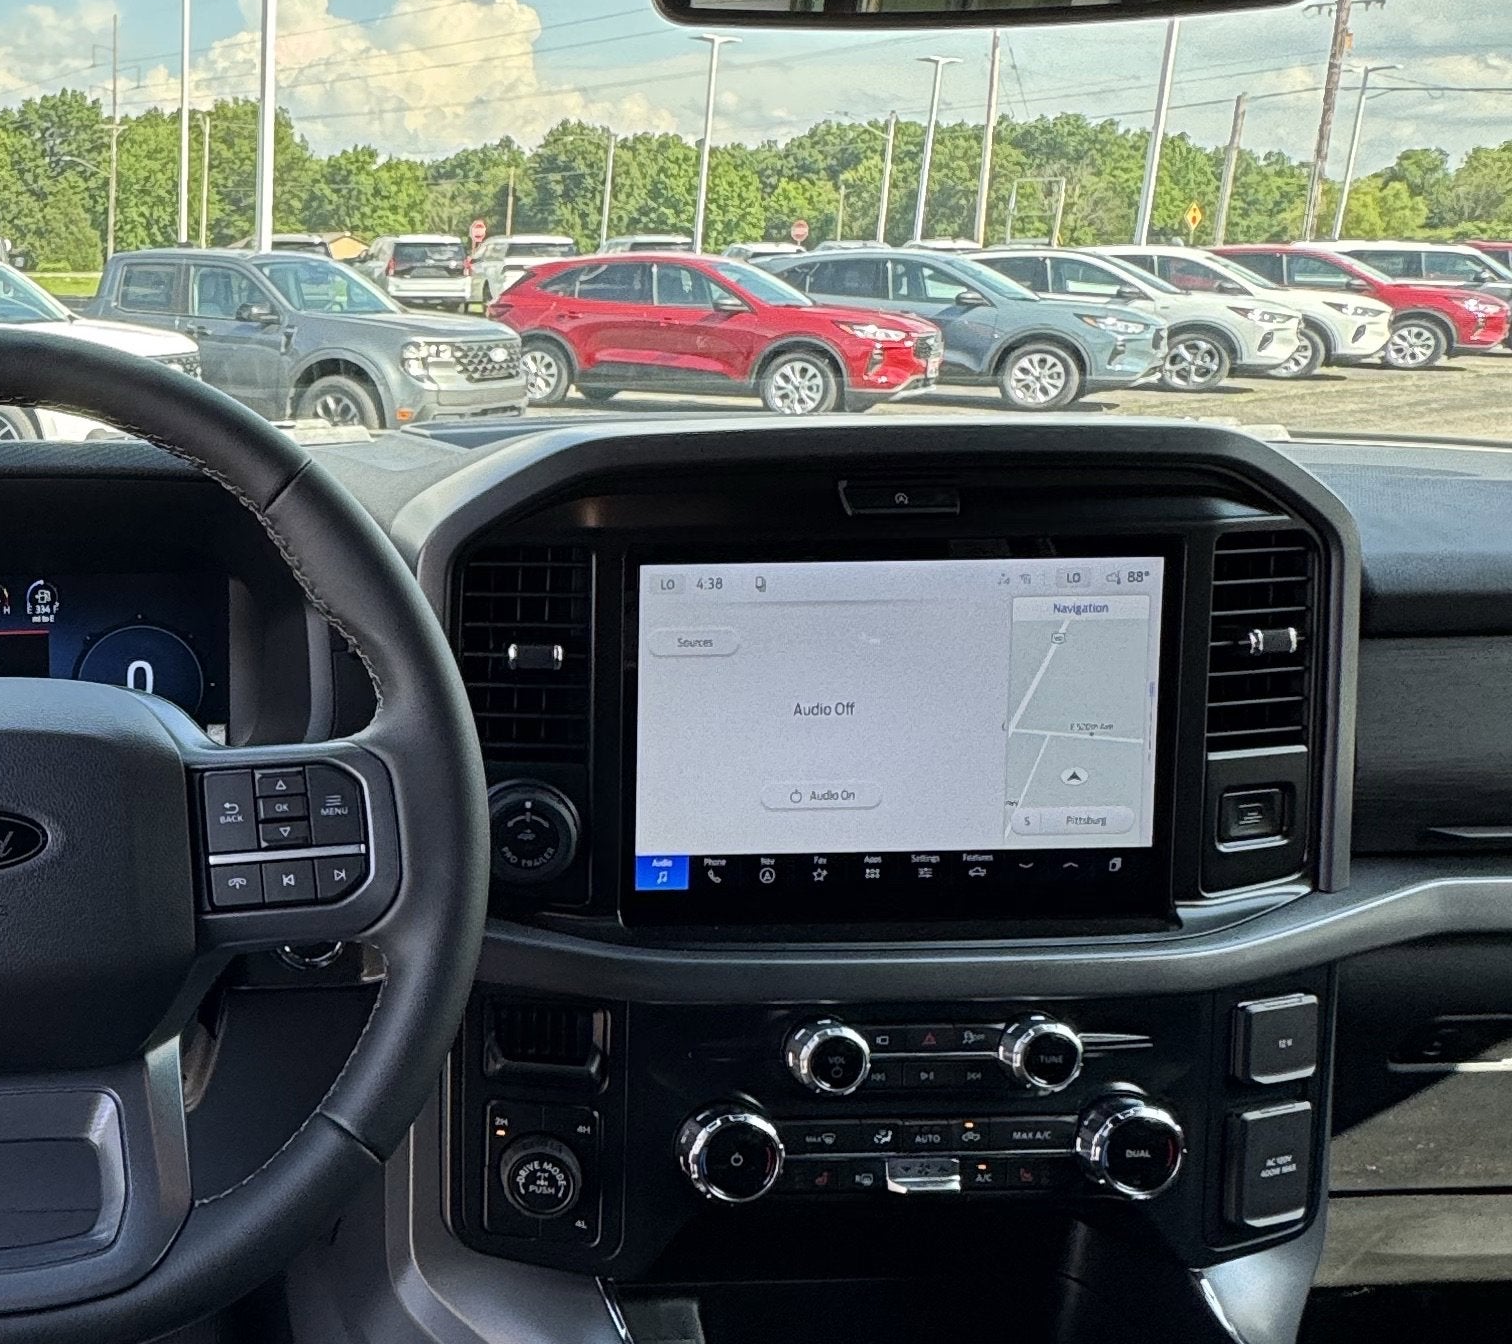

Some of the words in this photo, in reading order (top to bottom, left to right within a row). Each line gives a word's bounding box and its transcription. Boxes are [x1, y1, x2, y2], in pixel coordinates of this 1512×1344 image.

[1066, 572, 1081, 583] LO
[660, 578, 675, 590] LO
[696, 577, 723, 590] 4:38
[1053, 603, 1109, 615] Navigation
[677, 637, 713, 648] Sources
[127, 660, 154, 695] 0
[793, 702, 832, 716] Audio
[835, 701, 855, 716] Off
[809, 790, 839, 801] Audio
[840, 789, 856, 801] On
[274, 803, 289, 813] OK
[320, 807, 349, 816] MENU
[219, 815, 244, 824] BACK
[1066, 816, 1107, 827] Pittsburg
[651, 858, 673, 868] Audio
[1038, 1054, 1064, 1065] TUNE
[915, 1134, 941, 1144] AUTO
[1034, 1130, 1052, 1141] A/C
[1125, 1148, 1151, 1159] DUAL
[516, 1160, 540, 1184] DRIVE
[542, 1161, 567, 1188] MODE
[975, 1172, 993, 1183] A/C
[528, 1184, 555, 1195] PUSH
